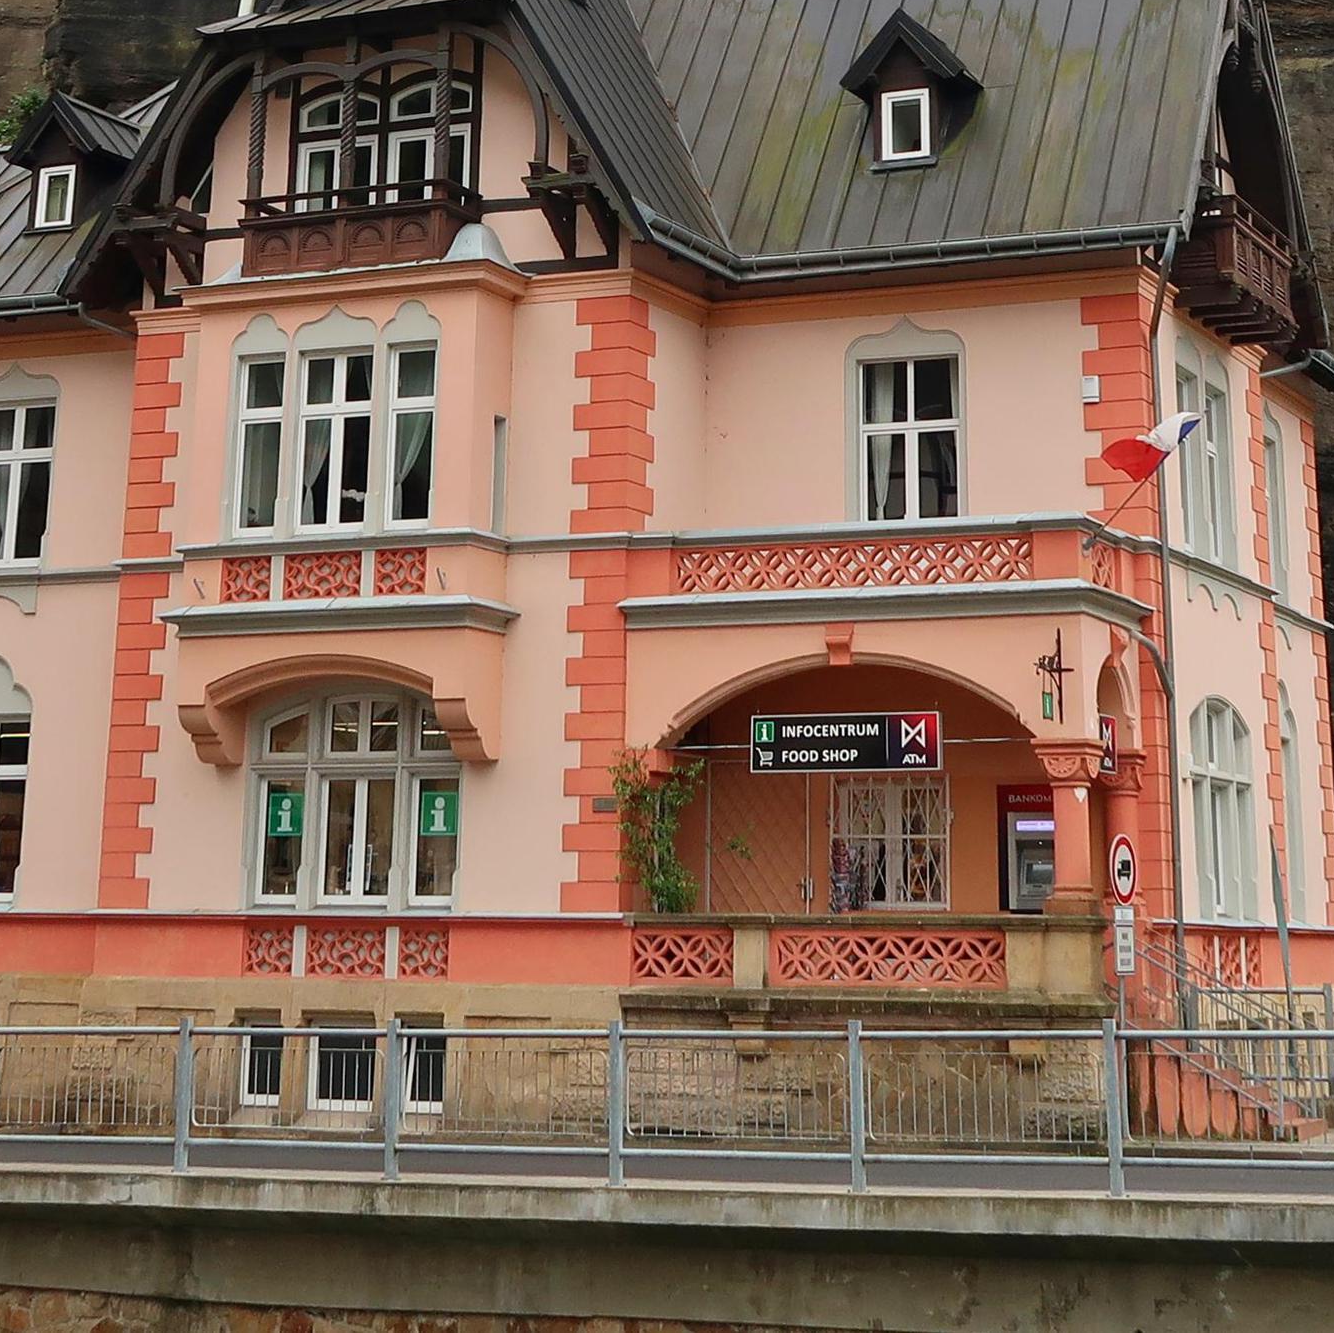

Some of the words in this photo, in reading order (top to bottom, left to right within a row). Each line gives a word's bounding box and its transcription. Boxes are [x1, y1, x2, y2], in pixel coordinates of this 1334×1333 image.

[781, 723, 880, 739] INFOCENTRUM
[781, 749, 819, 764] FOOD
[822, 748, 859, 763] SHOP
[902, 753, 927, 765] ATM
